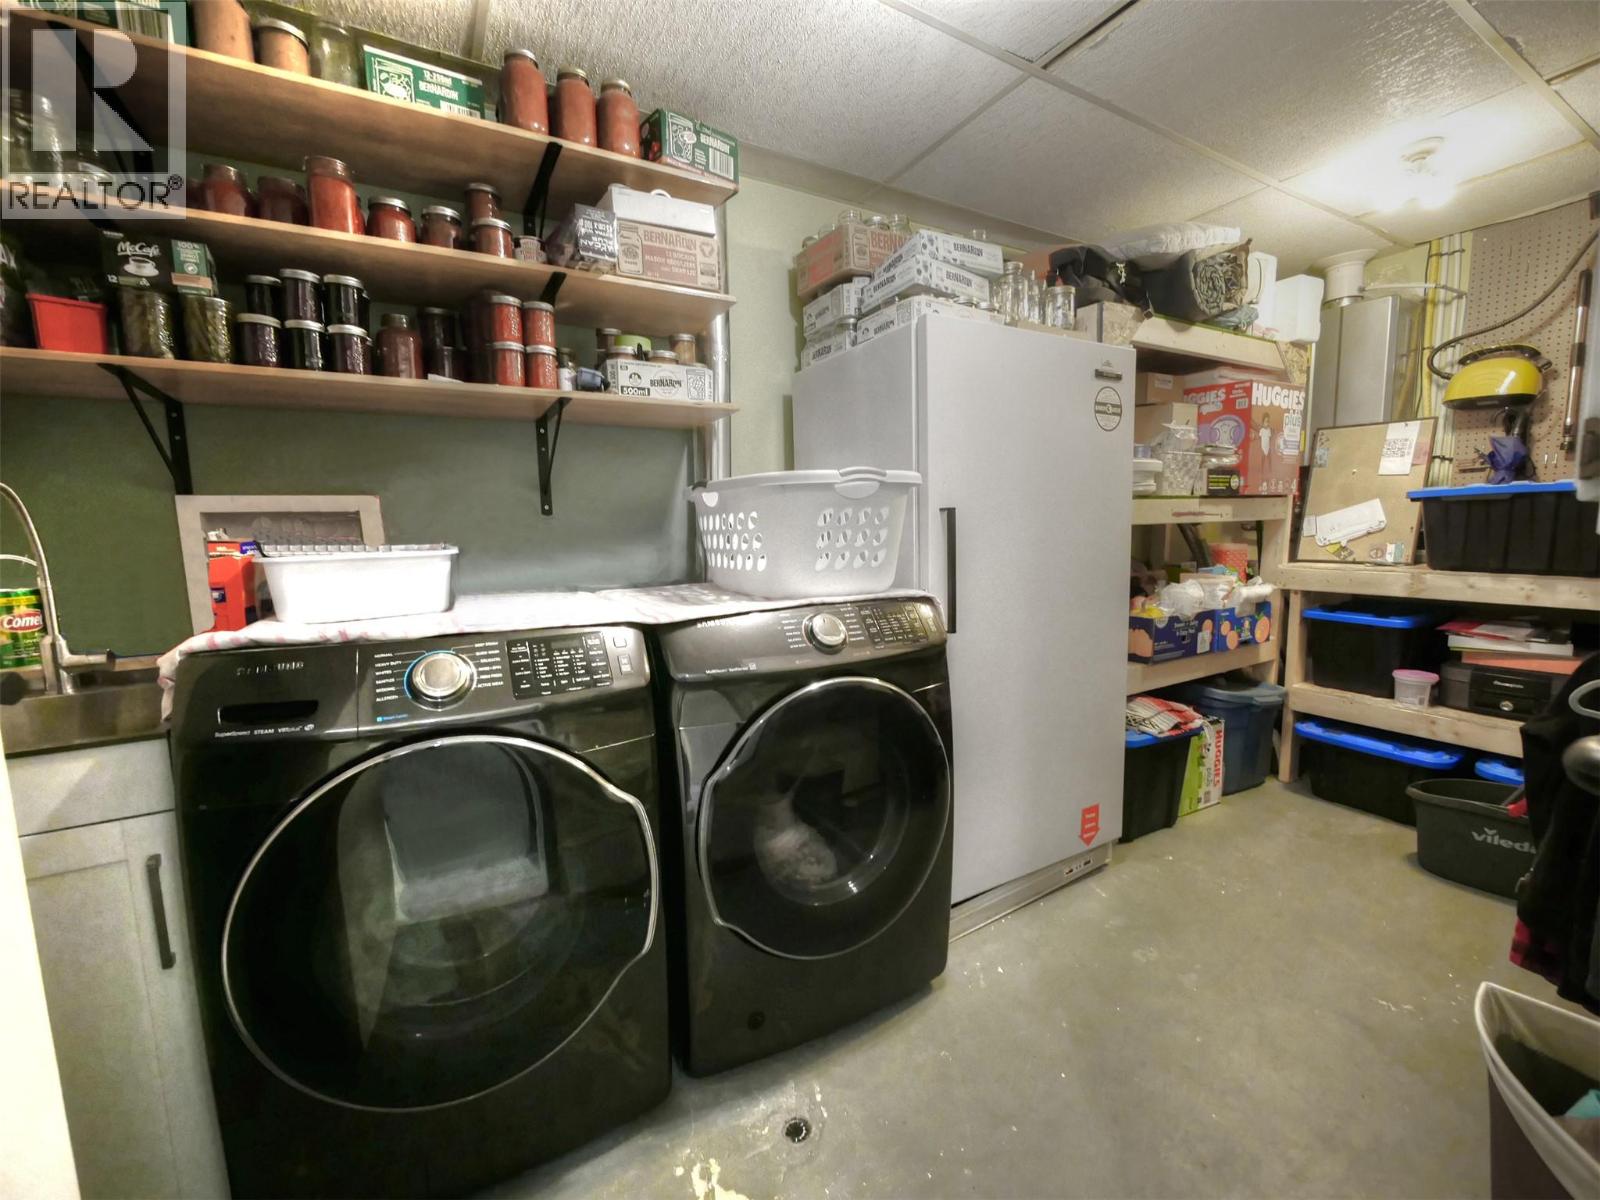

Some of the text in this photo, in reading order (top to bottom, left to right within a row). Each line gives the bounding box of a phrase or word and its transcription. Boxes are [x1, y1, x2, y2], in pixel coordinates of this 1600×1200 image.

[643, 229, 697, 251] BERNARDIN
[953, 242, 984, 257] BERNARDIN
[945, 270, 973, 288] BERNARDIN
[622, 386, 649, 396] 500ml
[649, 378, 682, 389] BERNARDIN
[1184, 389, 1226, 404] GGIES
[1251, 382, 1305, 410] HUGGIES
[1214, 729, 1223, 788] HUGGIES
